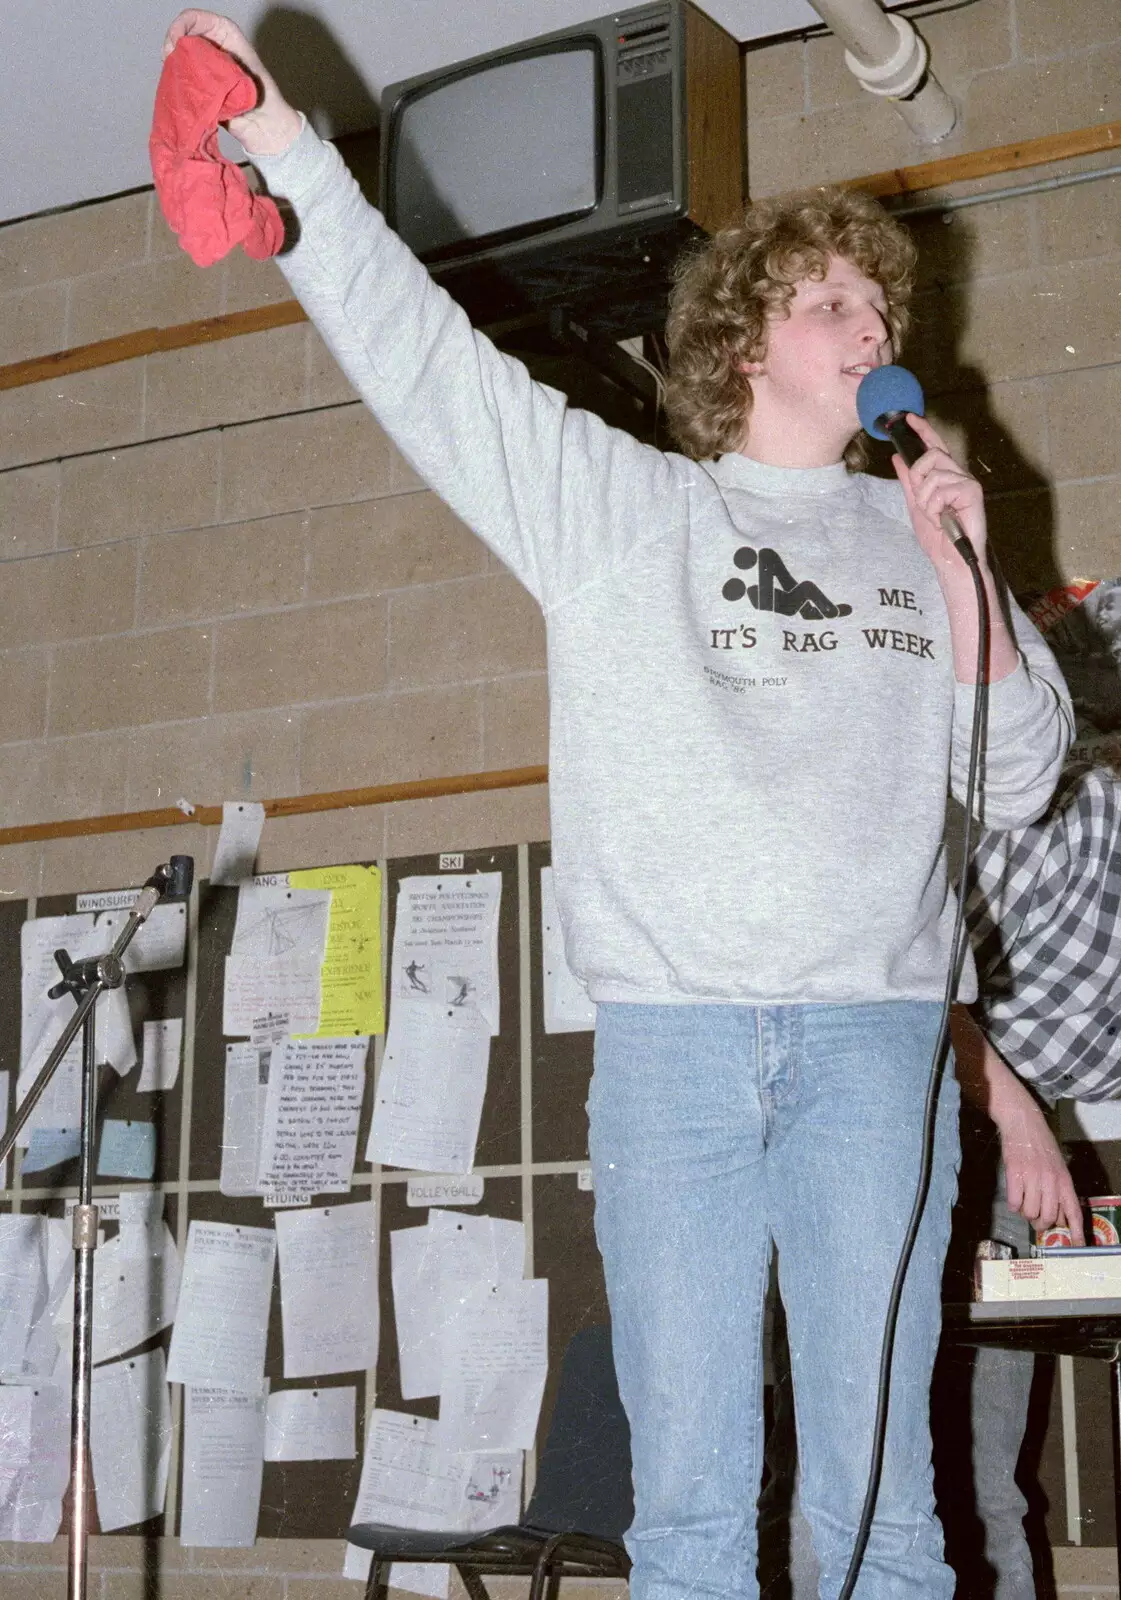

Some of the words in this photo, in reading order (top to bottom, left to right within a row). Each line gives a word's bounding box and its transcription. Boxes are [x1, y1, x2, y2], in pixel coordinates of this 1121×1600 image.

[878, 588, 922, 615] ME,
[711, 625, 756, 649] IT'S
[783, 631, 838, 651] RAG
[862, 629, 934, 659] WEEK
[762, 677, 788, 687] POLY
[441, 857, 461, 869] SKI
[410, 1186, 481, 1198] VOLLEYBALL
[265, 1194, 309, 1204] RIDING
